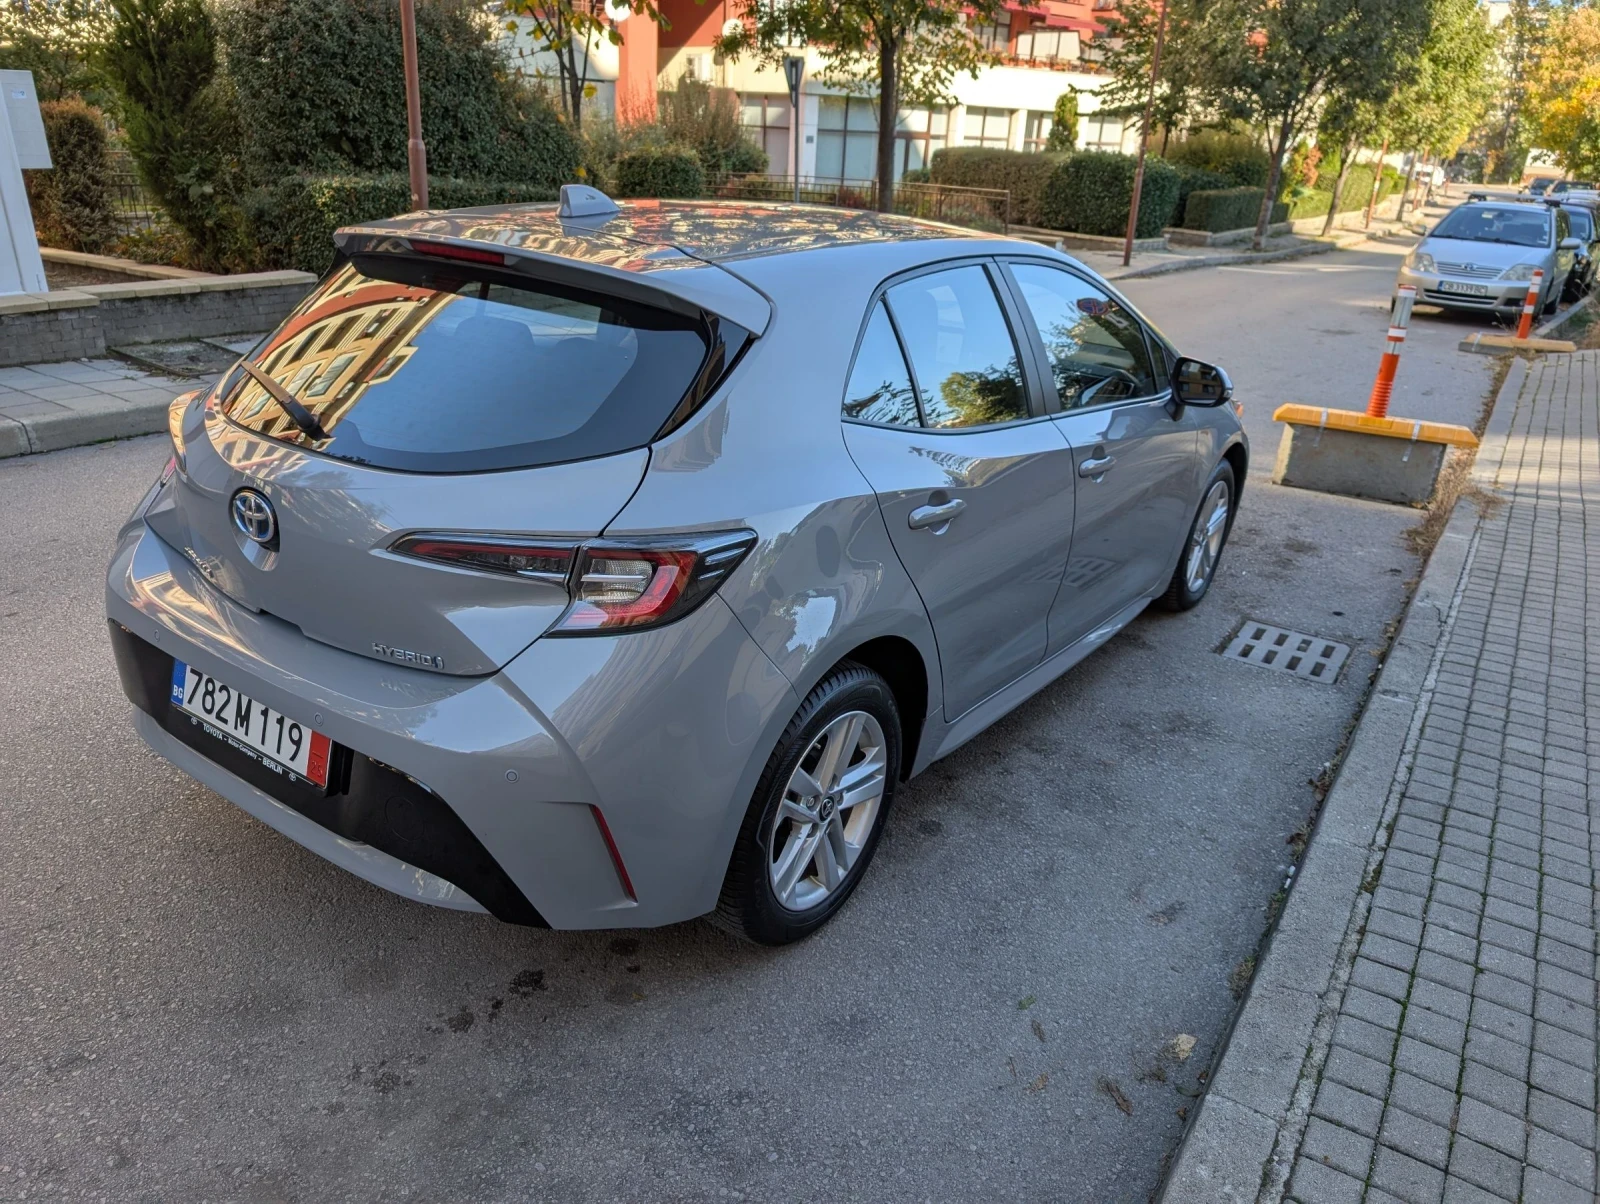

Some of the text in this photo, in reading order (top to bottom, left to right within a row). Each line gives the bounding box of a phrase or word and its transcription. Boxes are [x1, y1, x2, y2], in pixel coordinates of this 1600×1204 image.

[372, 642, 432, 666] HYBRID
[173, 684, 184, 699] BG
[203, 723, 223, 740] TOYOTA
[263, 758, 282, 775] BERLIN
